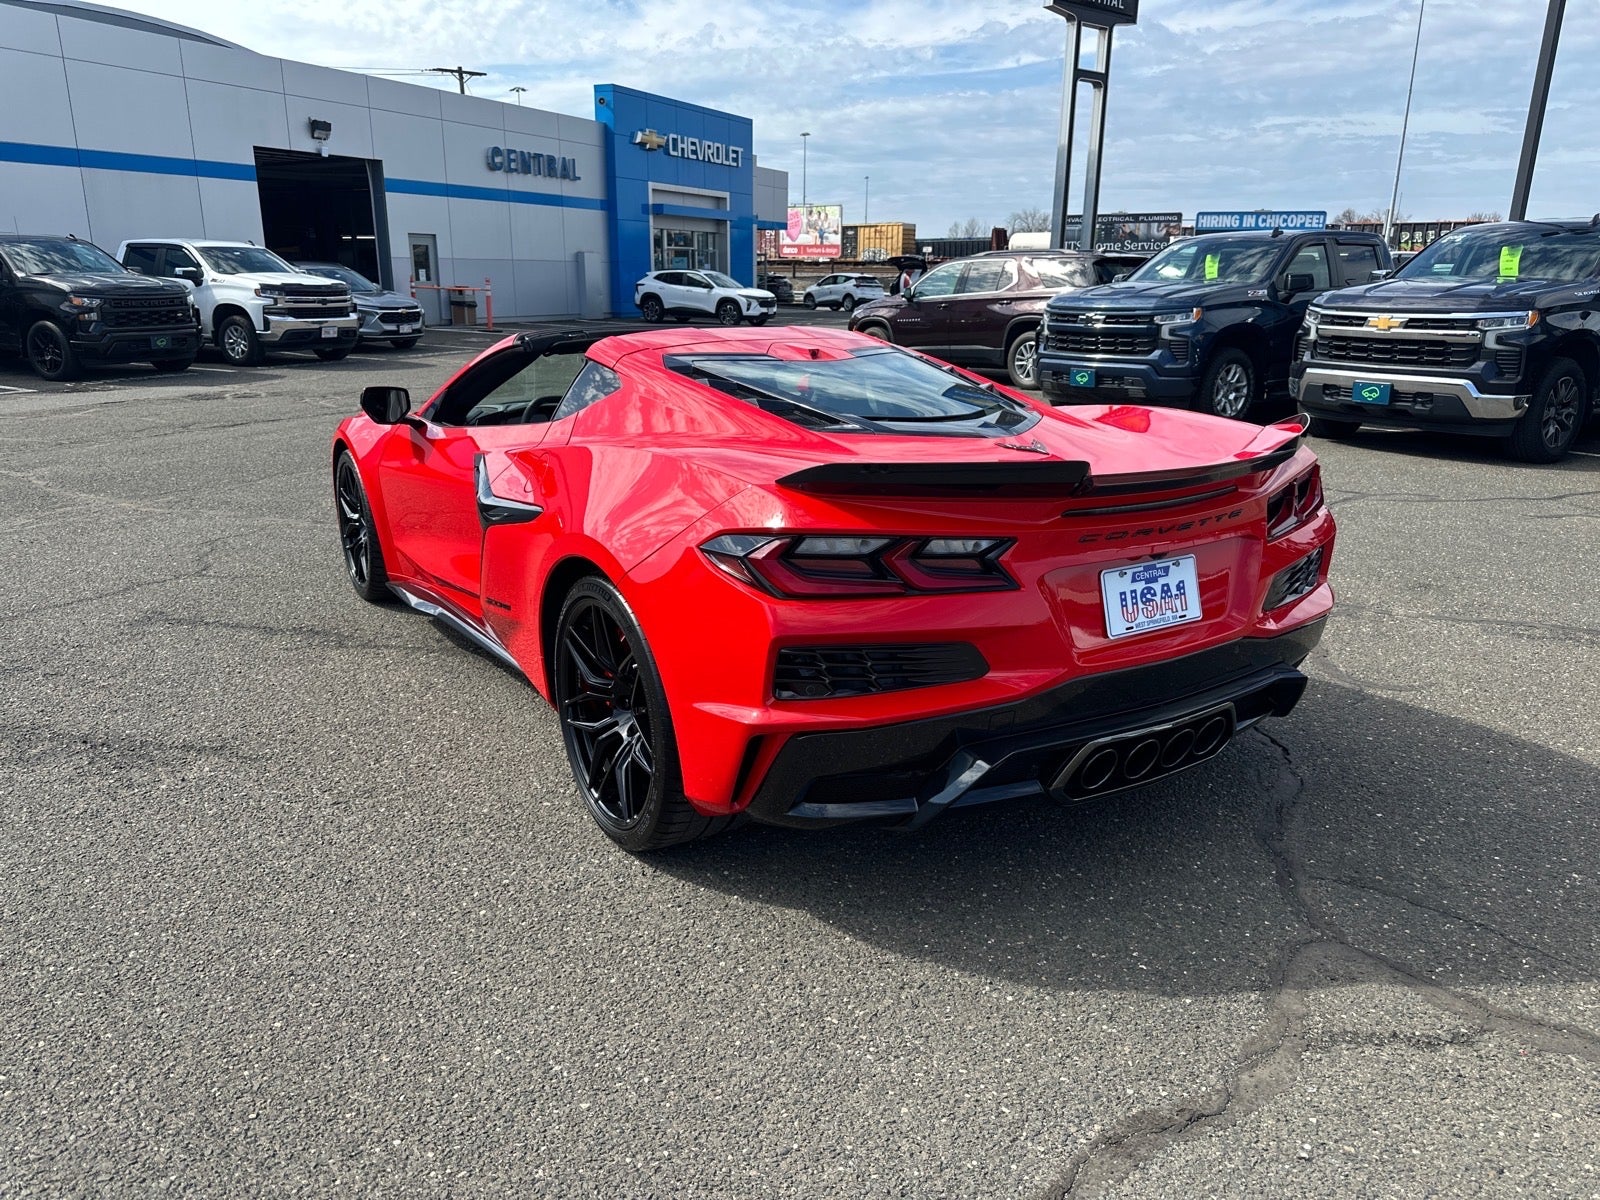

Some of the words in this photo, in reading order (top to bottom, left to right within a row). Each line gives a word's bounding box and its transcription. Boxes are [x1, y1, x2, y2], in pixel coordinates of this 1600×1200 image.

[668, 134, 743, 167] CHEVROLET
[486, 146, 581, 182] CENTRAL
[1197, 214, 1240, 228] HIRING
[1242, 214, 1256, 228] IN
[1257, 213, 1324, 228] CHICOPEE!
[1095, 241, 1122, 251] ome
[1123, 239, 1170, 251] Service
[1079, 509, 1243, 543] CORVETTE
[1135, 568, 1167, 580] CENTRAL
[1134, 620, 1146, 629] WEST
